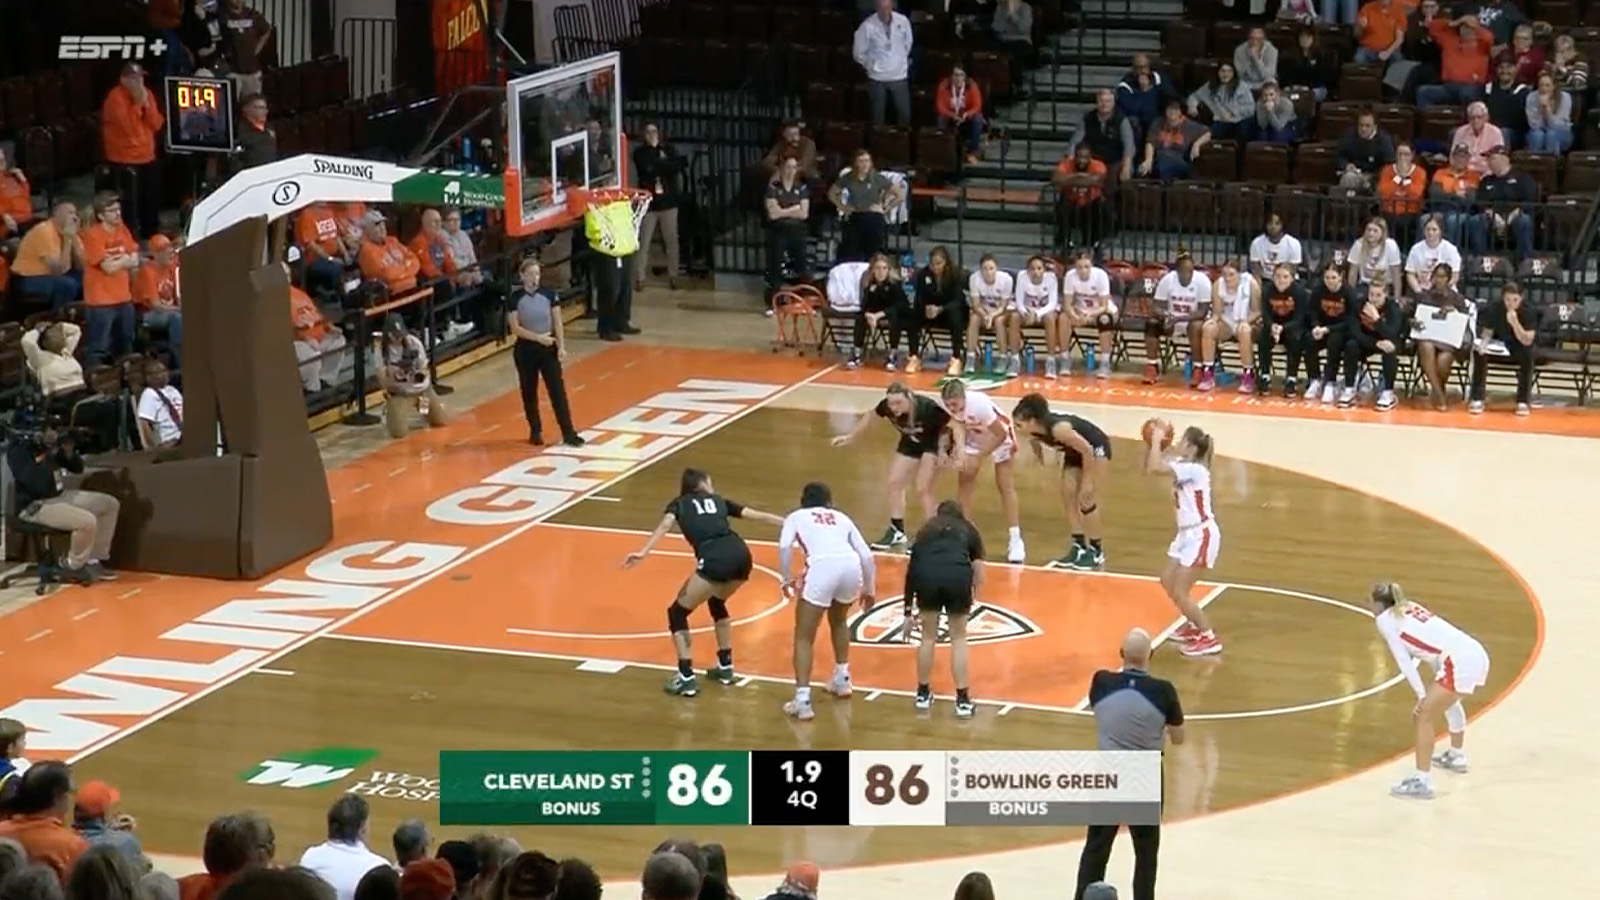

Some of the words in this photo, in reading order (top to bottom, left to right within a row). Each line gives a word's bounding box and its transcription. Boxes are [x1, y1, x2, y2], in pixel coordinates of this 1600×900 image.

[178, 87, 216, 109] 01.9
[313, 159, 374, 180] SPALDING
[425, 378, 787, 525] GREEN
[692, 498, 718, 515] 10
